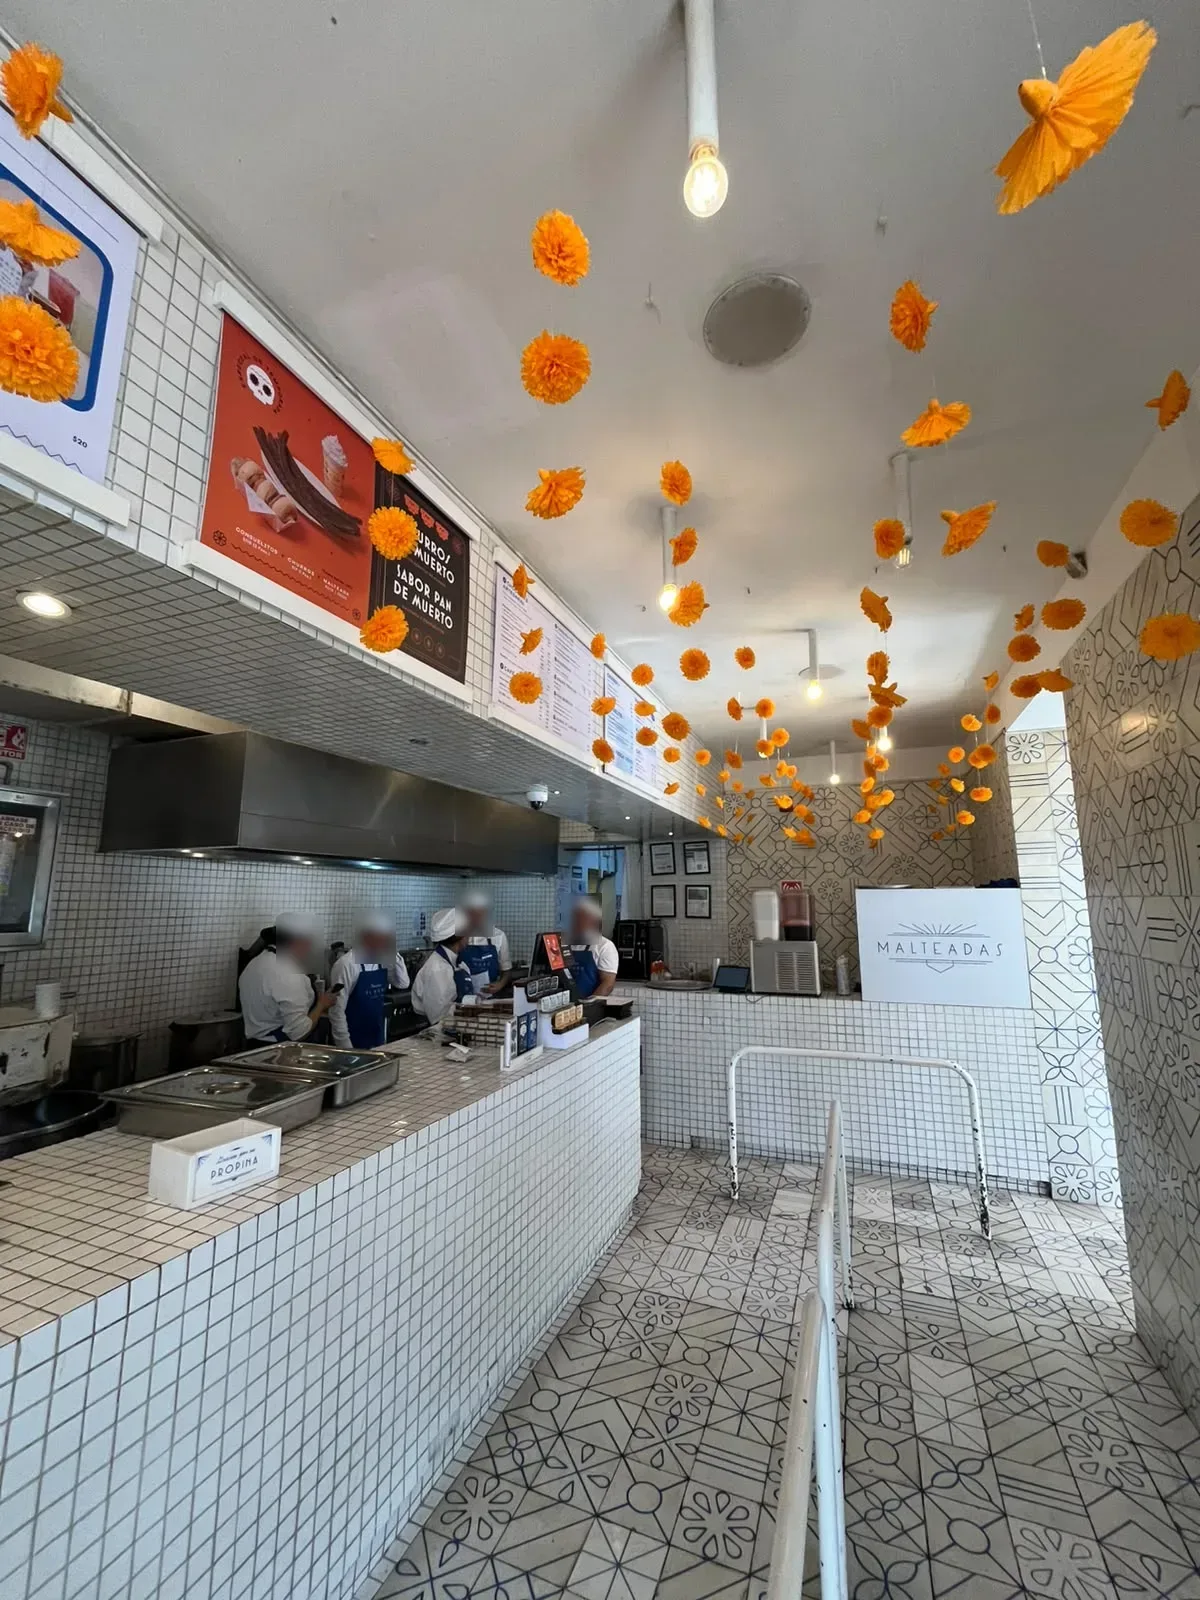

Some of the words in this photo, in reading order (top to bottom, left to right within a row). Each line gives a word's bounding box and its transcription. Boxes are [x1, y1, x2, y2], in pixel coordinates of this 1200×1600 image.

[414, 546, 455, 584] MUERTO
[416, 529, 451, 565] URROS
[287, 557, 315, 577] CHURROS
[393, 579, 409, 601] DE
[411, 594, 454, 630] MUERTO
[396, 564, 431, 599] SABOR
[434, 590, 452, 613] PAN
[876, 940, 1003, 957] MALTEADAS
[210, 1156, 258, 1180] PROPINA
